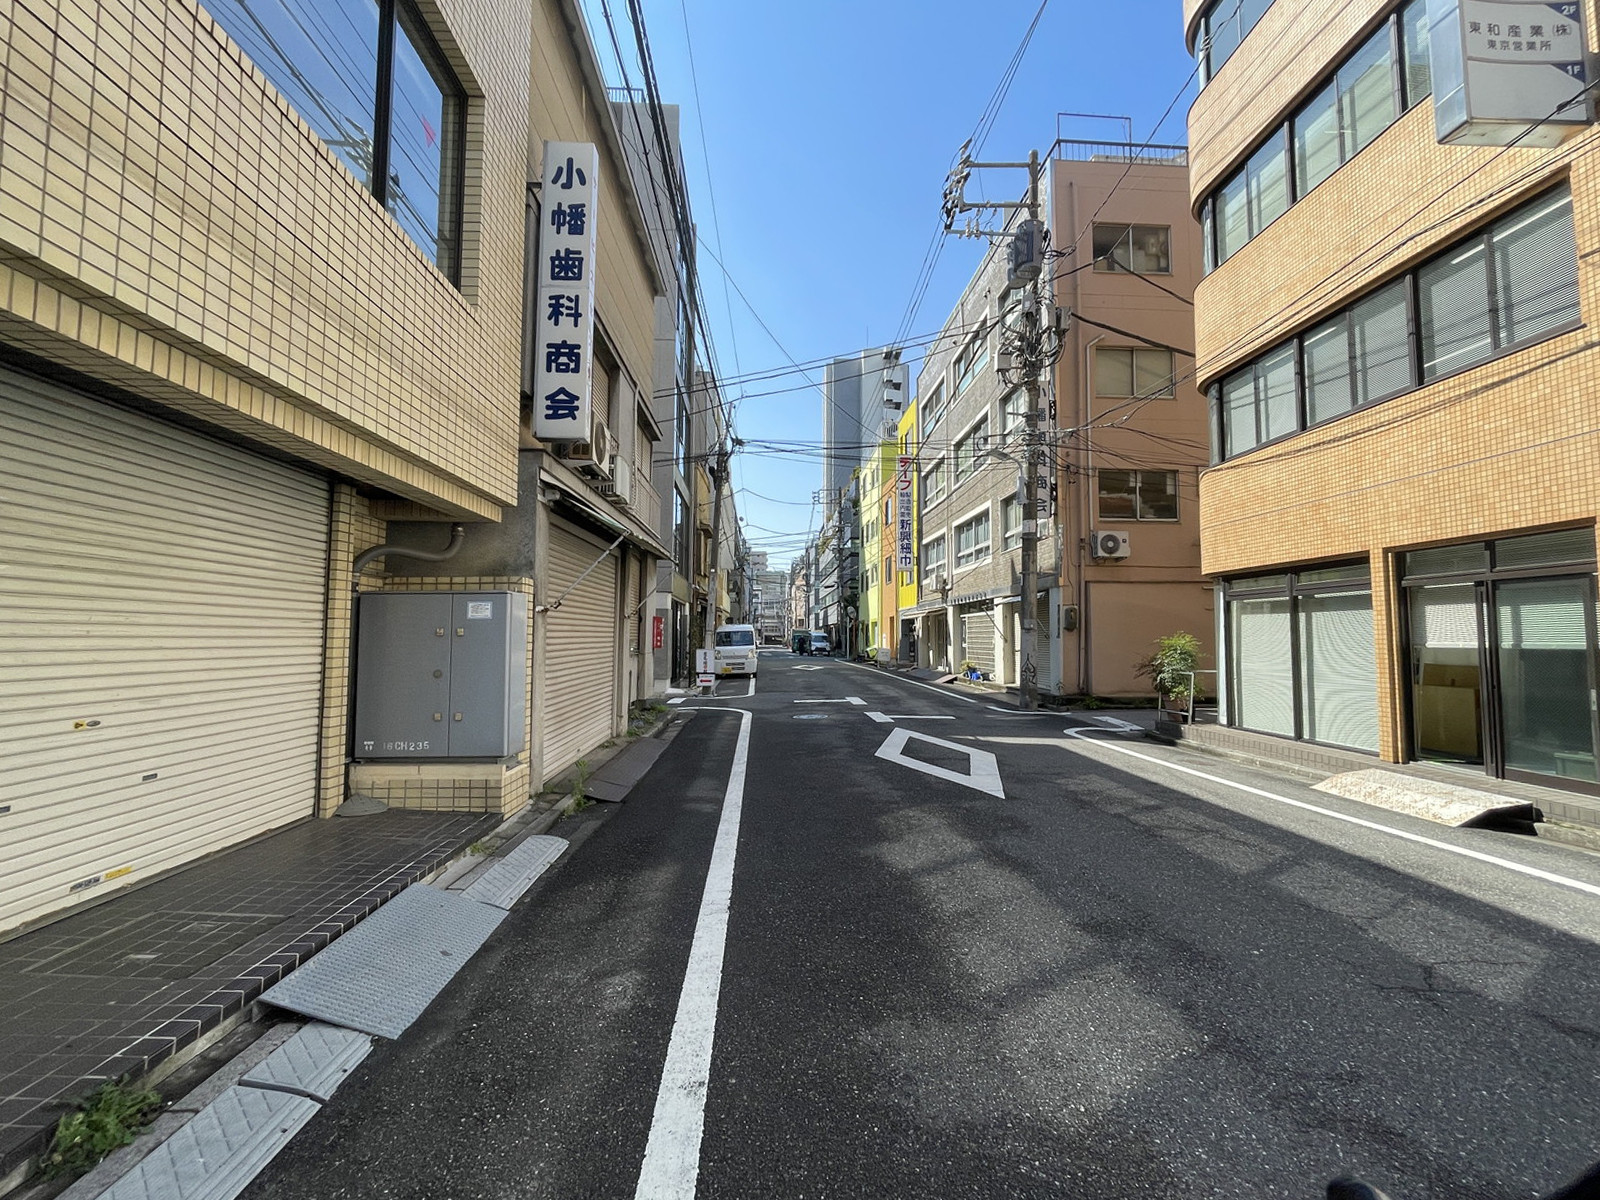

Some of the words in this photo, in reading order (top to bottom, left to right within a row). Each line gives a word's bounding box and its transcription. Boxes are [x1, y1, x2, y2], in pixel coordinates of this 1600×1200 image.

[1562, 5, 1577, 16] 2F
[1487, 40, 1553, 52] 東京営業所
[1566, 65, 1581, 75] 1F
[544, 157, 587, 421] 小幡歯科商会
